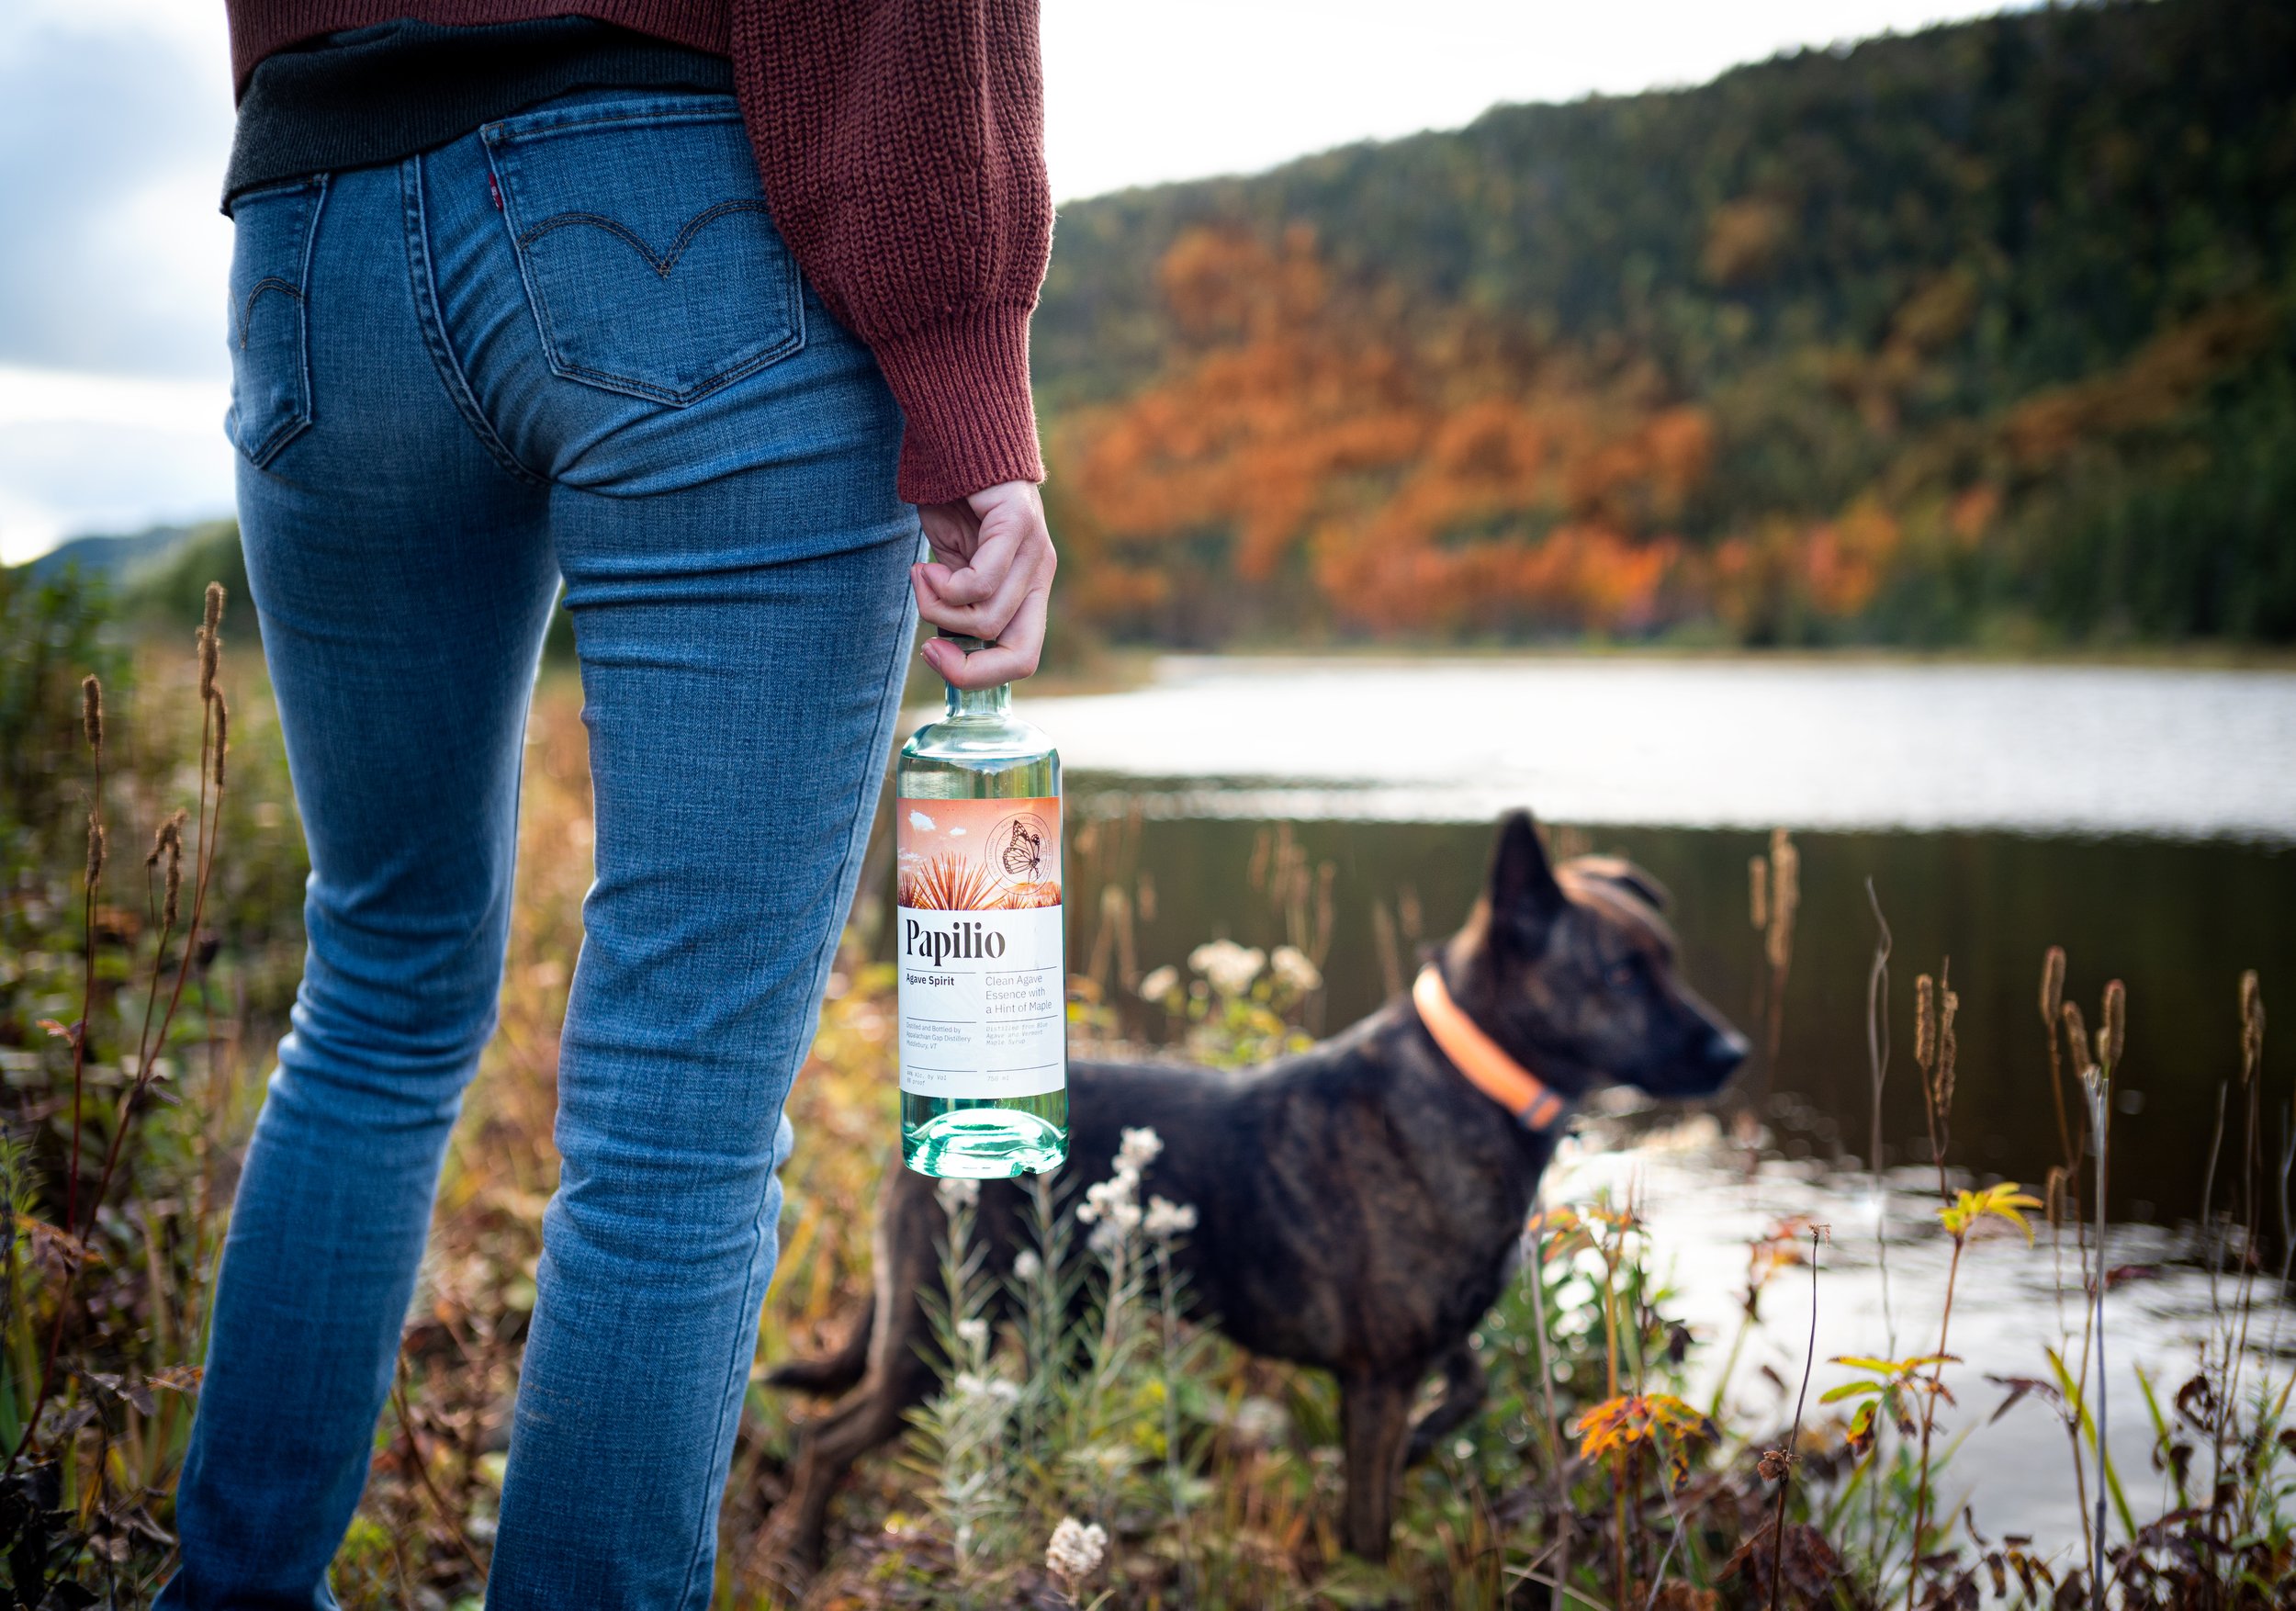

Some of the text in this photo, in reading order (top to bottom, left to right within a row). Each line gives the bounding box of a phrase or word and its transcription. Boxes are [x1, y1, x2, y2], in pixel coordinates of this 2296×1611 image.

[906, 918, 1006, 966] Papilio
[906, 974, 955, 987] Agave Spirit
[985, 974, 1042, 986] Clean Agave
[985, 987, 1046, 1000] Essence with
[985, 999, 1052, 1014] a Hint of Maple
[931, 1025, 952, 1033] Bottled
[953, 1026, 962, 1034] by
[944, 1034, 972, 1043] Distillery
